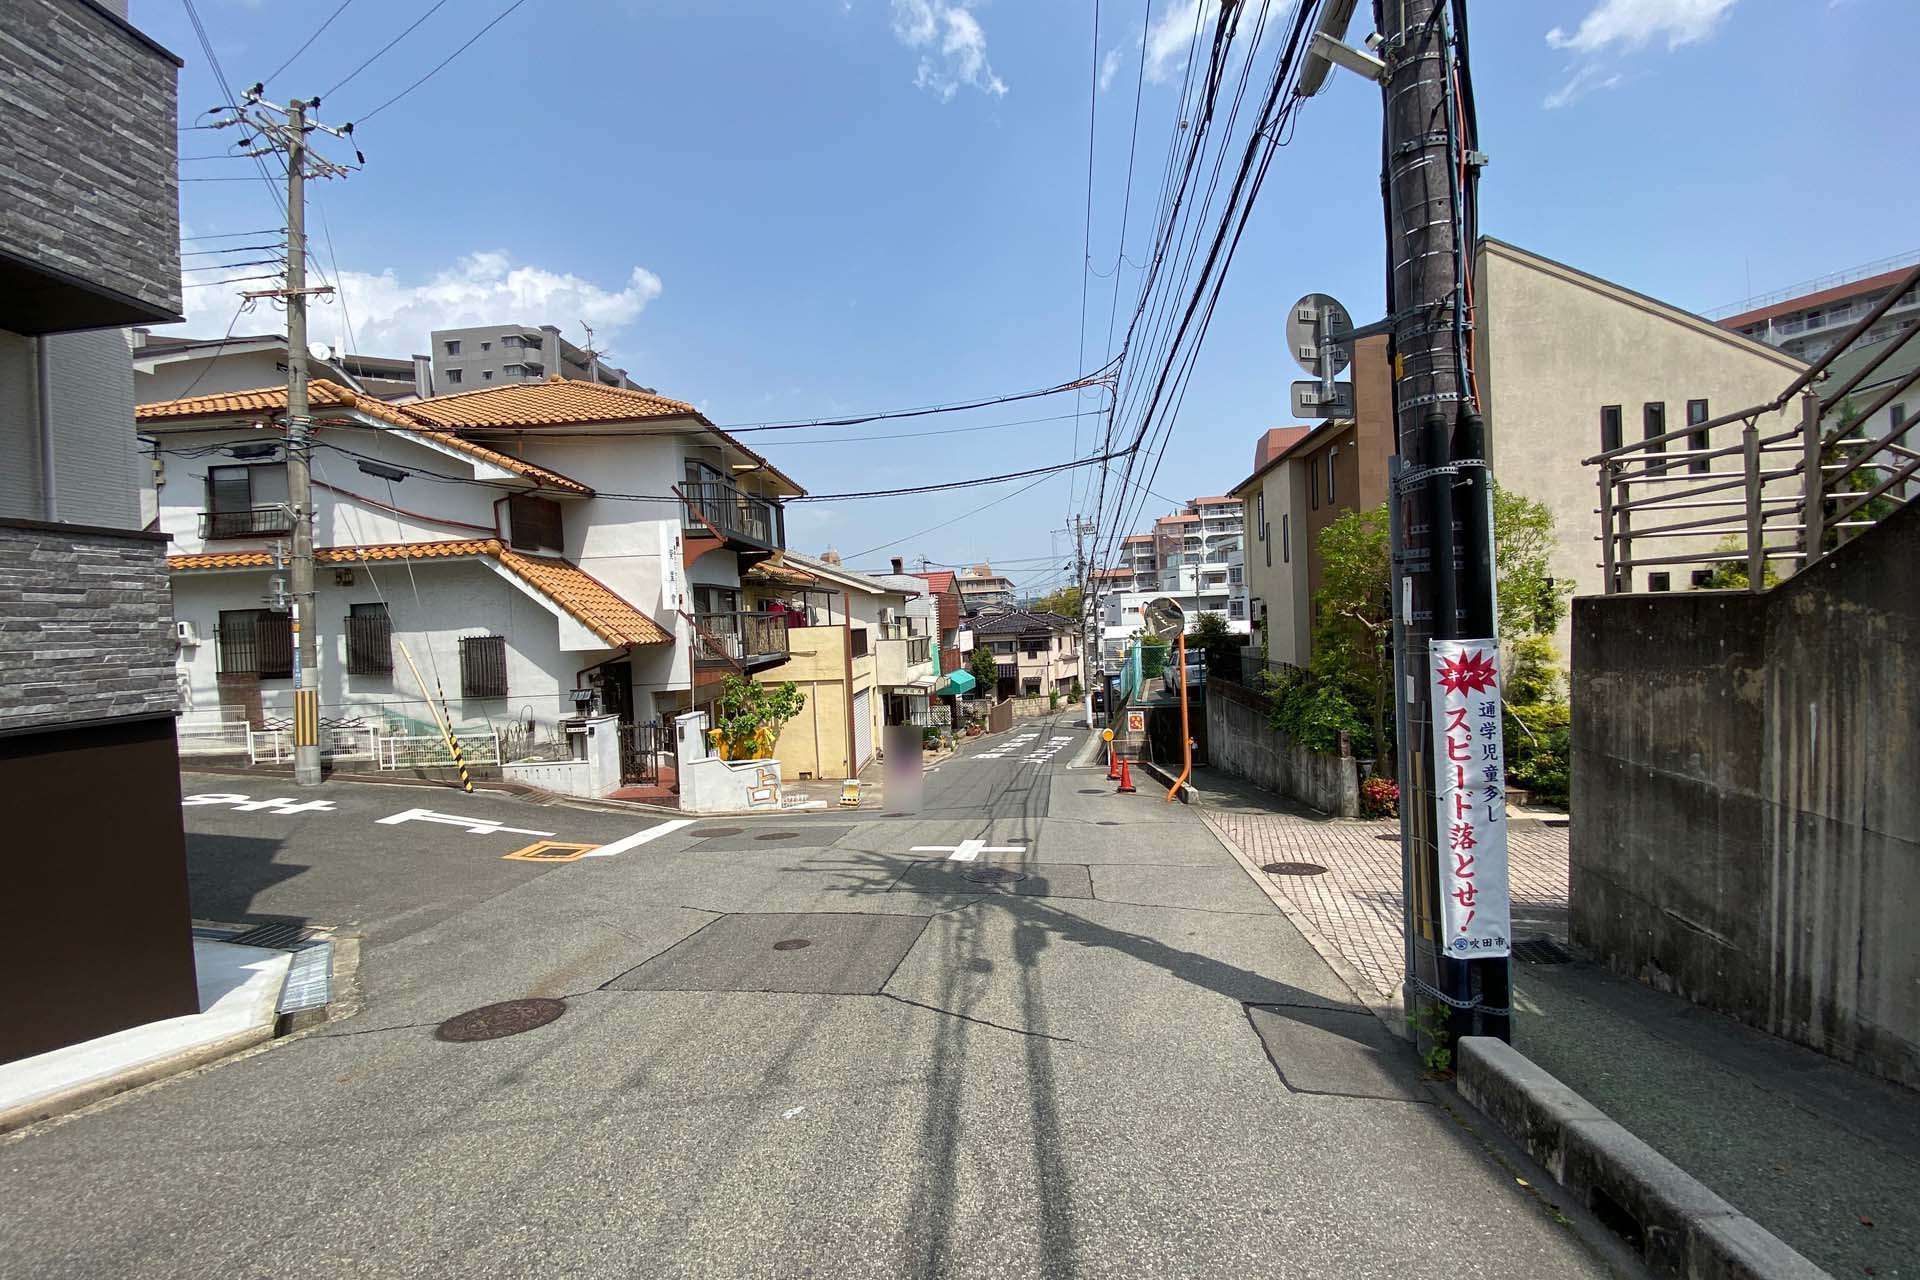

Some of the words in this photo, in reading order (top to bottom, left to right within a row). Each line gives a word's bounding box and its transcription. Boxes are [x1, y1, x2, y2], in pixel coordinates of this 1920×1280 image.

[1447, 669, 1490, 683] キケン
[1478, 701, 1499, 823] 通学児童多し
[1444, 706, 1479, 932] スピード落とせ！
[1469, 936, 1506, 949] 吹田市
